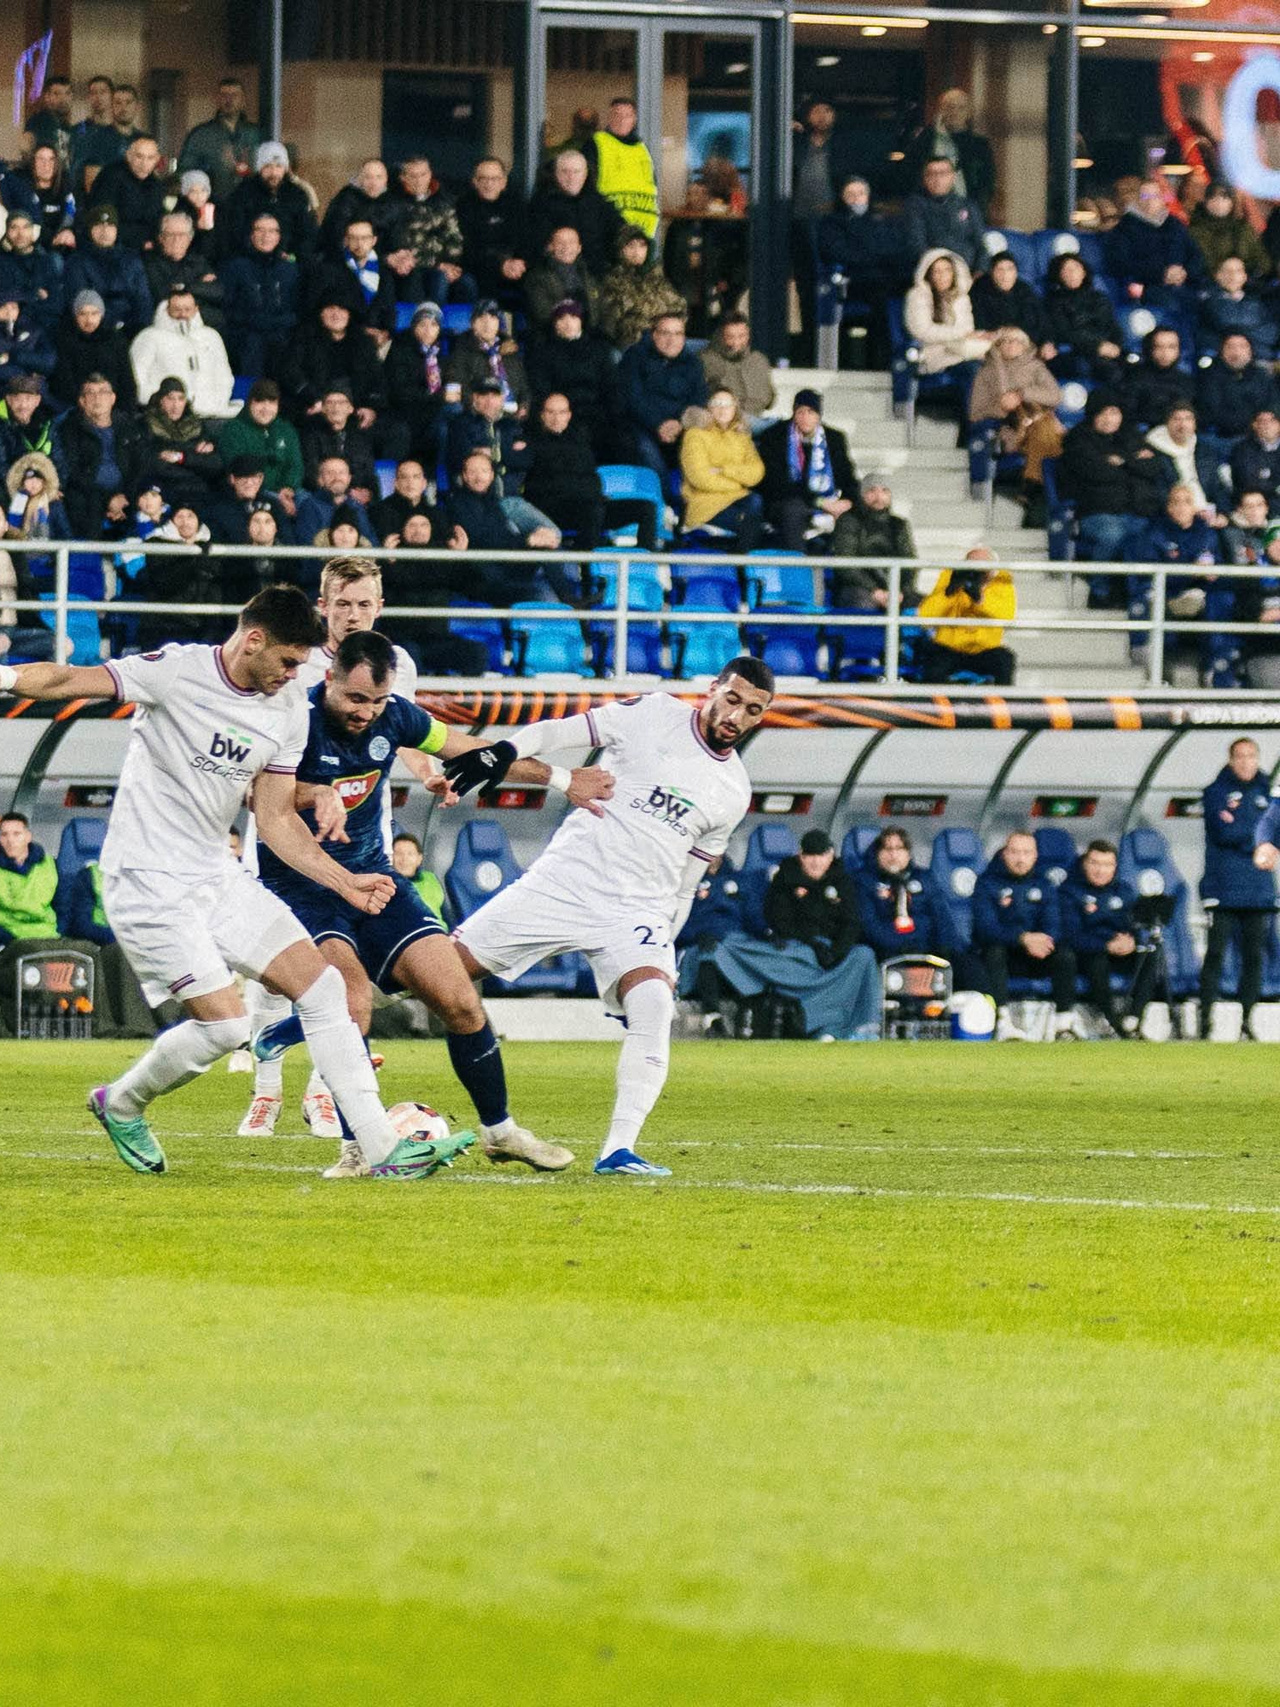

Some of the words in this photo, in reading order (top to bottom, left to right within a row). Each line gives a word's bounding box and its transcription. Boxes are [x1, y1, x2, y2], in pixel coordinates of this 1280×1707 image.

[209, 732, 252, 763] bw
[339, 780, 369, 798] MOL
[648, 786, 690, 820] bw
[633, 925, 668, 949] 2
